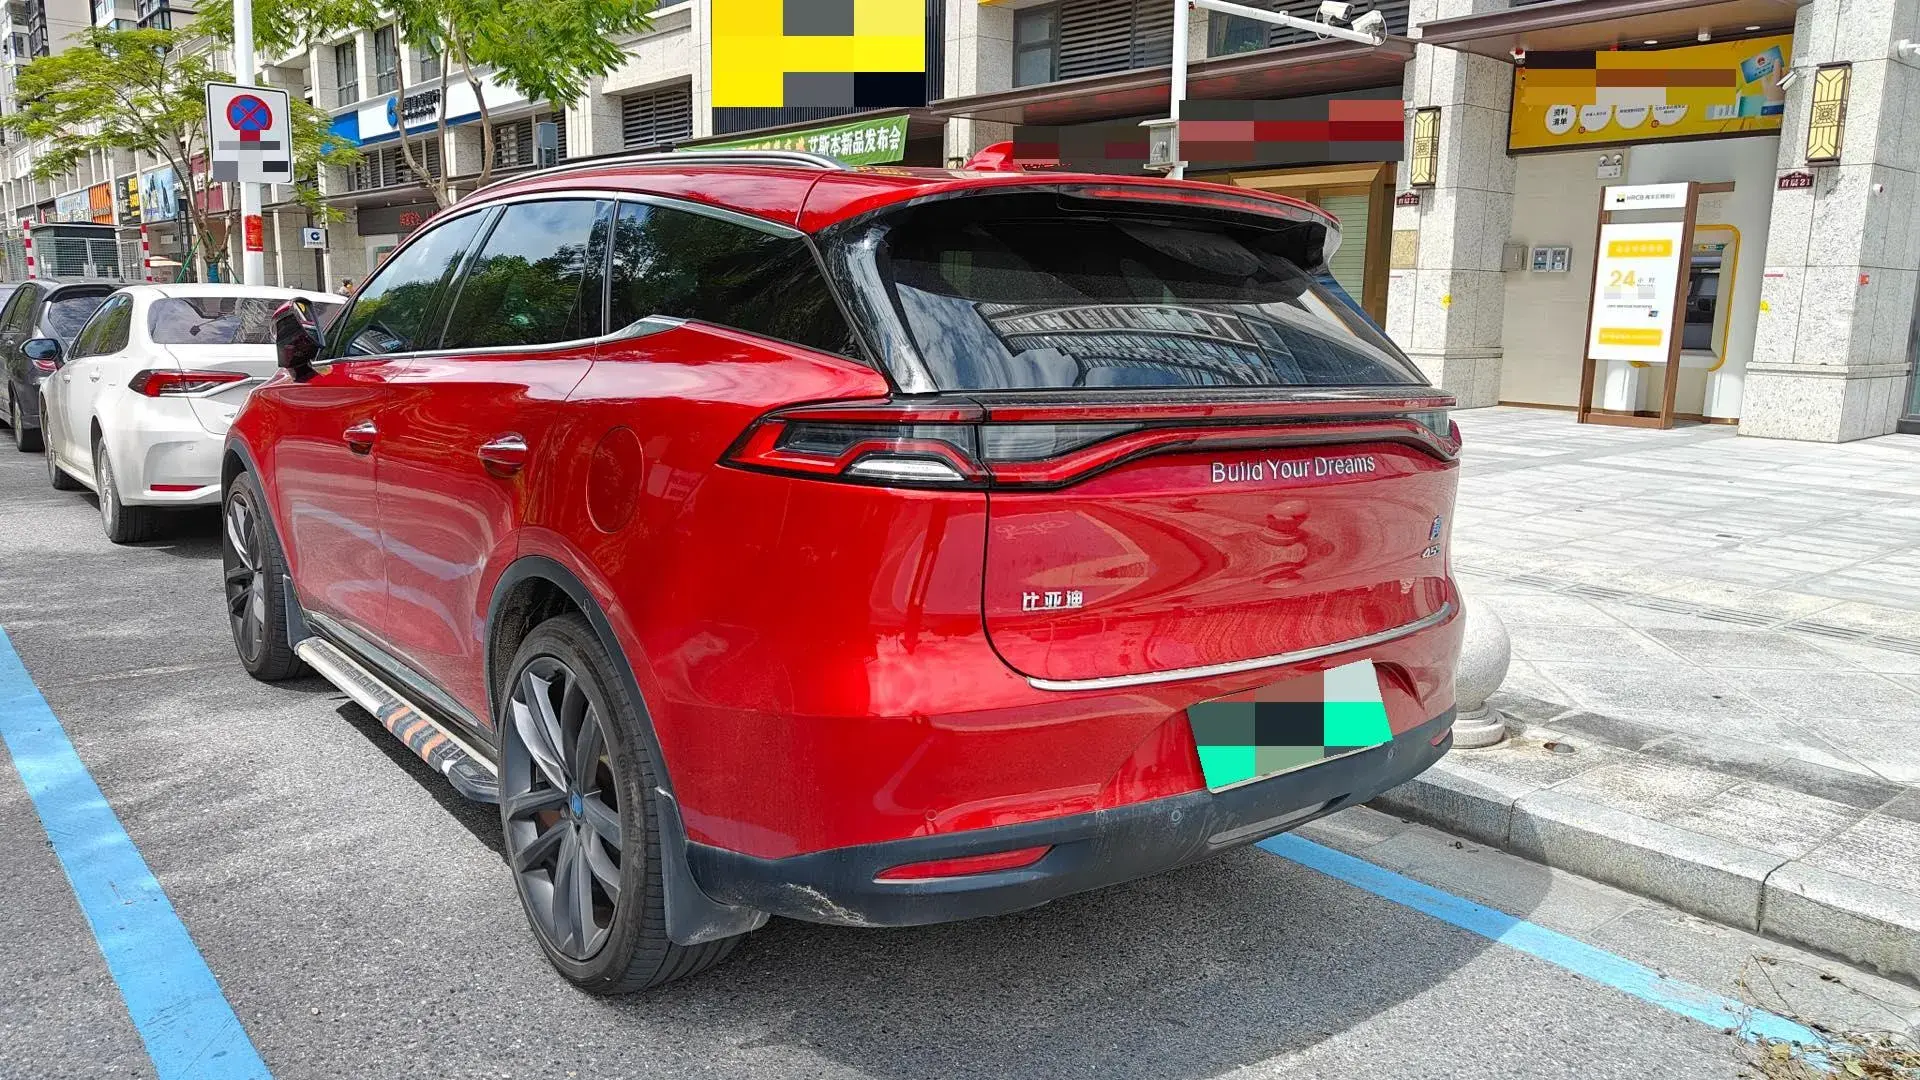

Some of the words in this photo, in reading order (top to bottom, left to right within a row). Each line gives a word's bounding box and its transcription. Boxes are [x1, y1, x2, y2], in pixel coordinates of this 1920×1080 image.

[1610, 269, 1636, 287] 24
[1211, 461, 1263, 483] Build
[1266, 458, 1310, 480] Your
[1314, 455, 1376, 476] Dreams
[1022, 590, 1083, 611] 比亚迪
